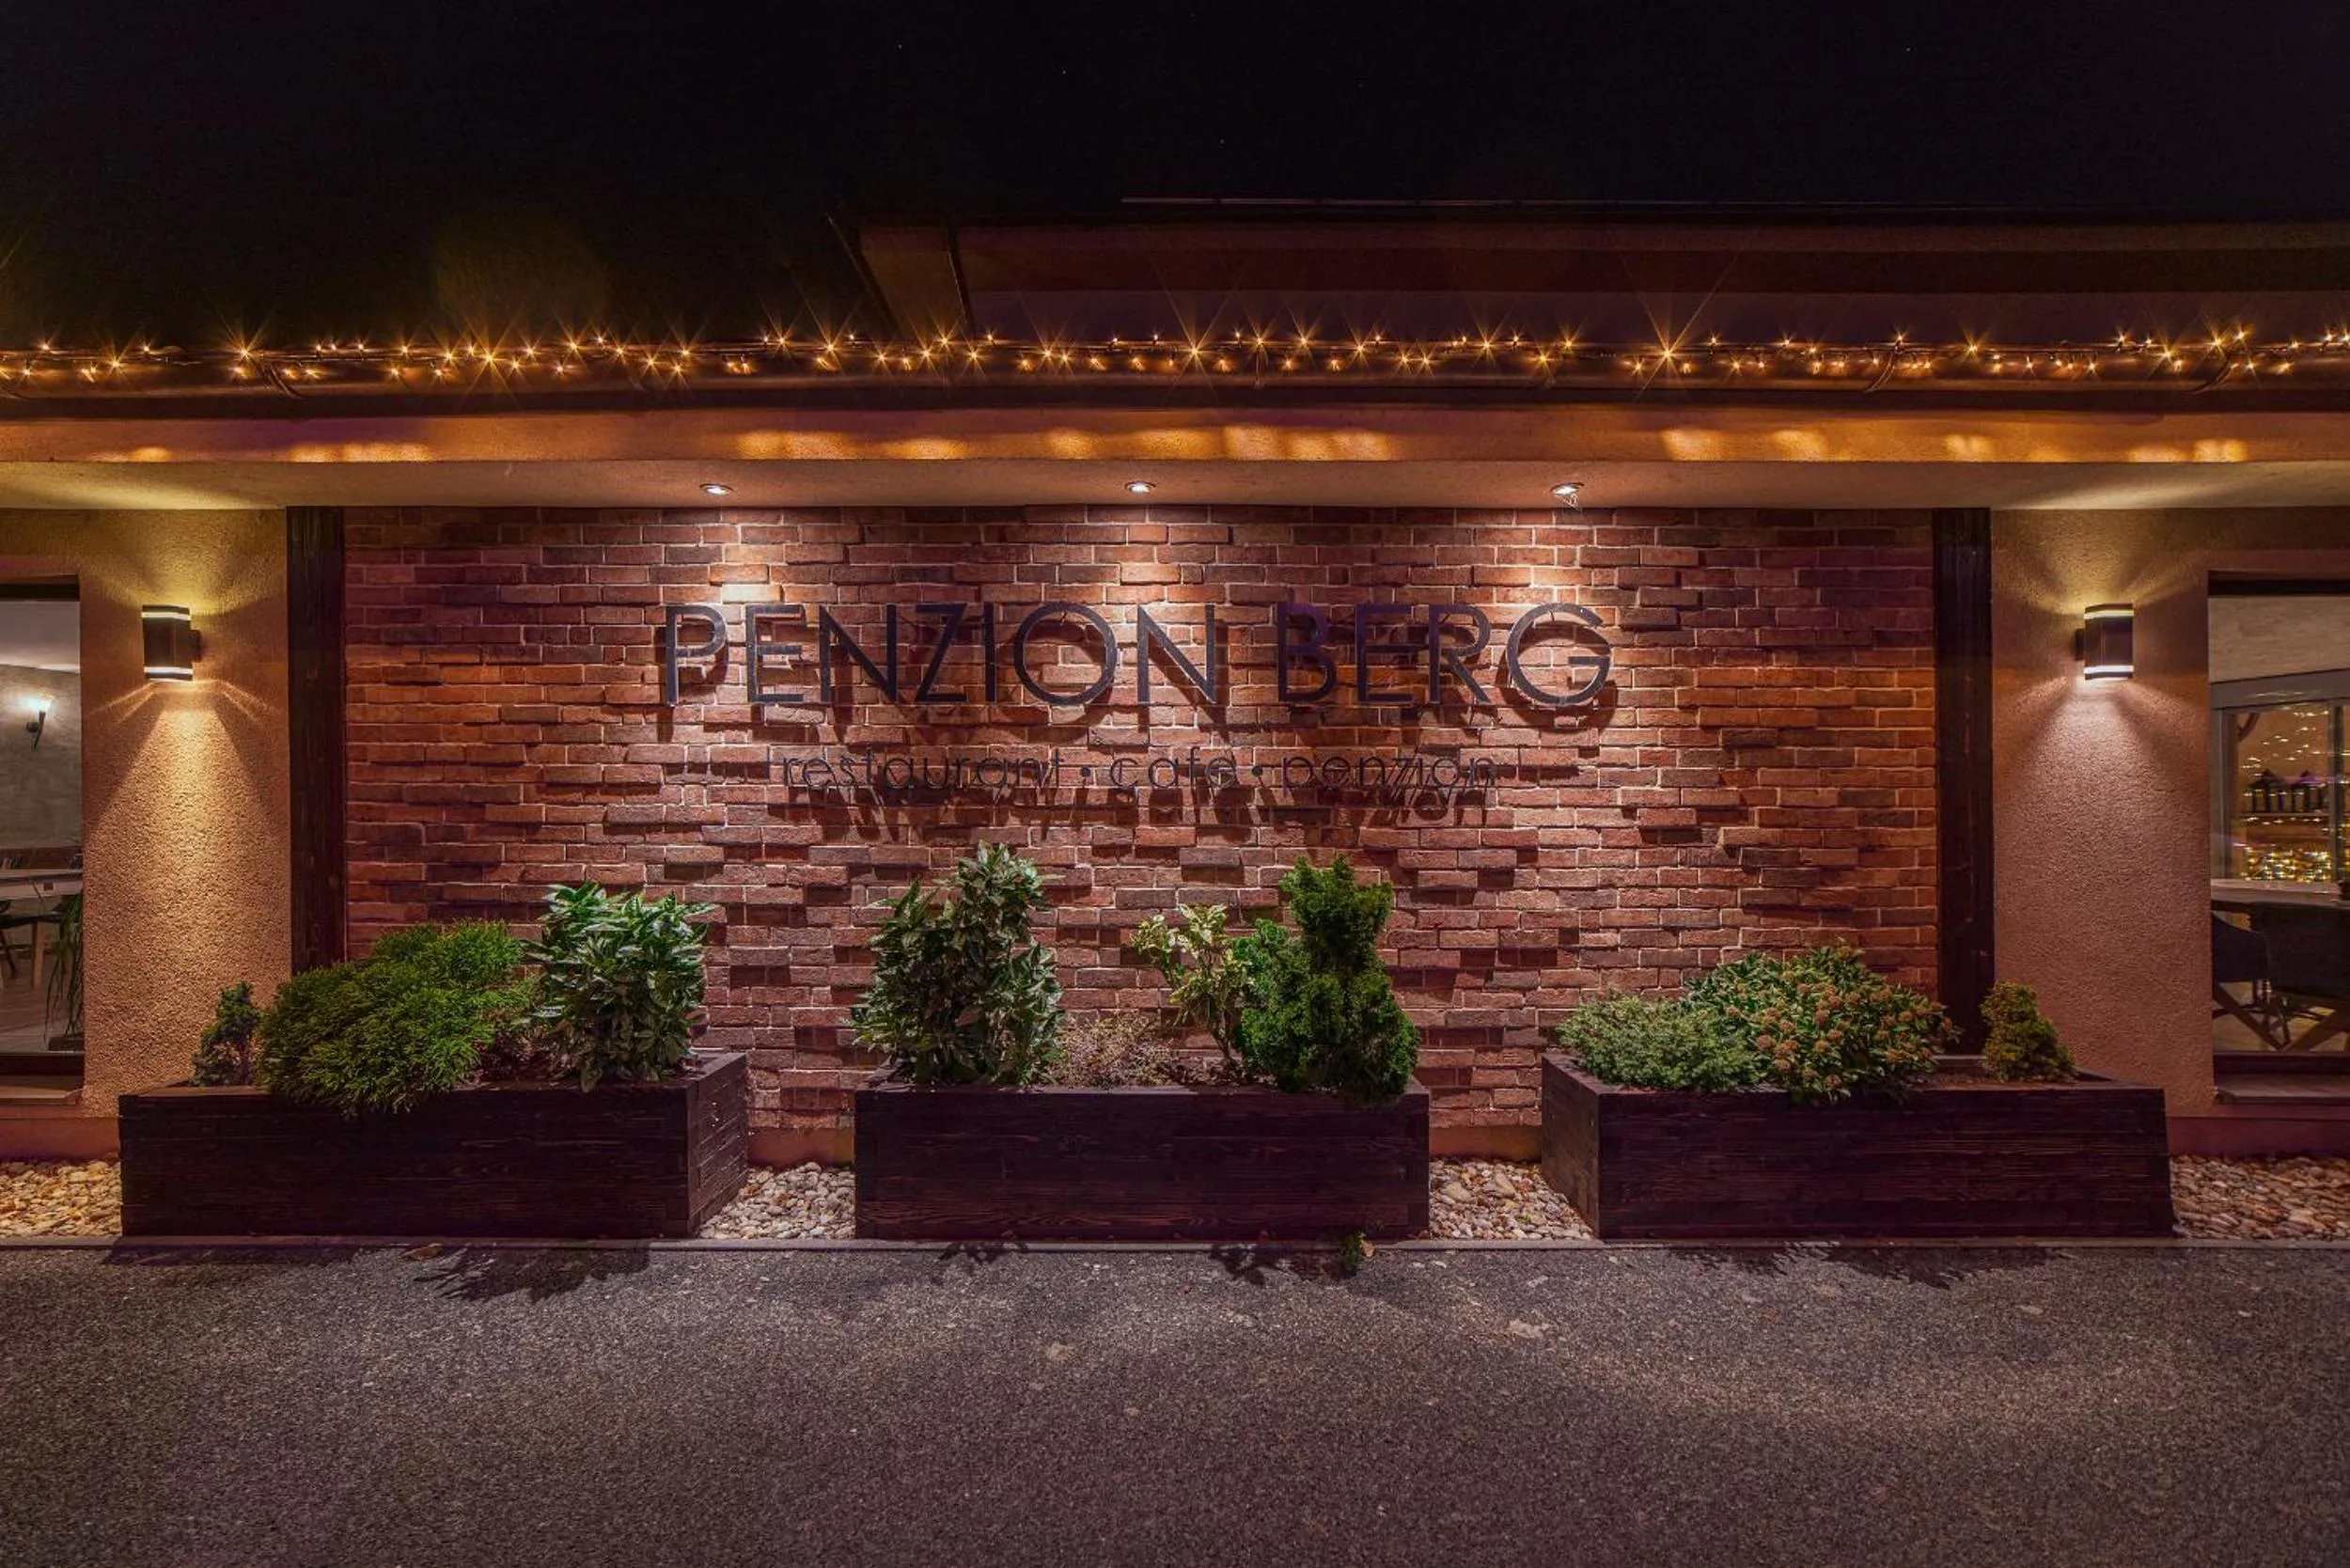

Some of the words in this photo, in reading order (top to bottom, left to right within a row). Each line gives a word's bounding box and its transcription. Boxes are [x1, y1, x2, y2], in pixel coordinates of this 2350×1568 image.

[665, 602, 1216, 705] PENZION
[1277, 602, 1612, 705] BERG
[784, 747, 1064, 789] restaurant
[1282, 753, 1496, 792] penzion
